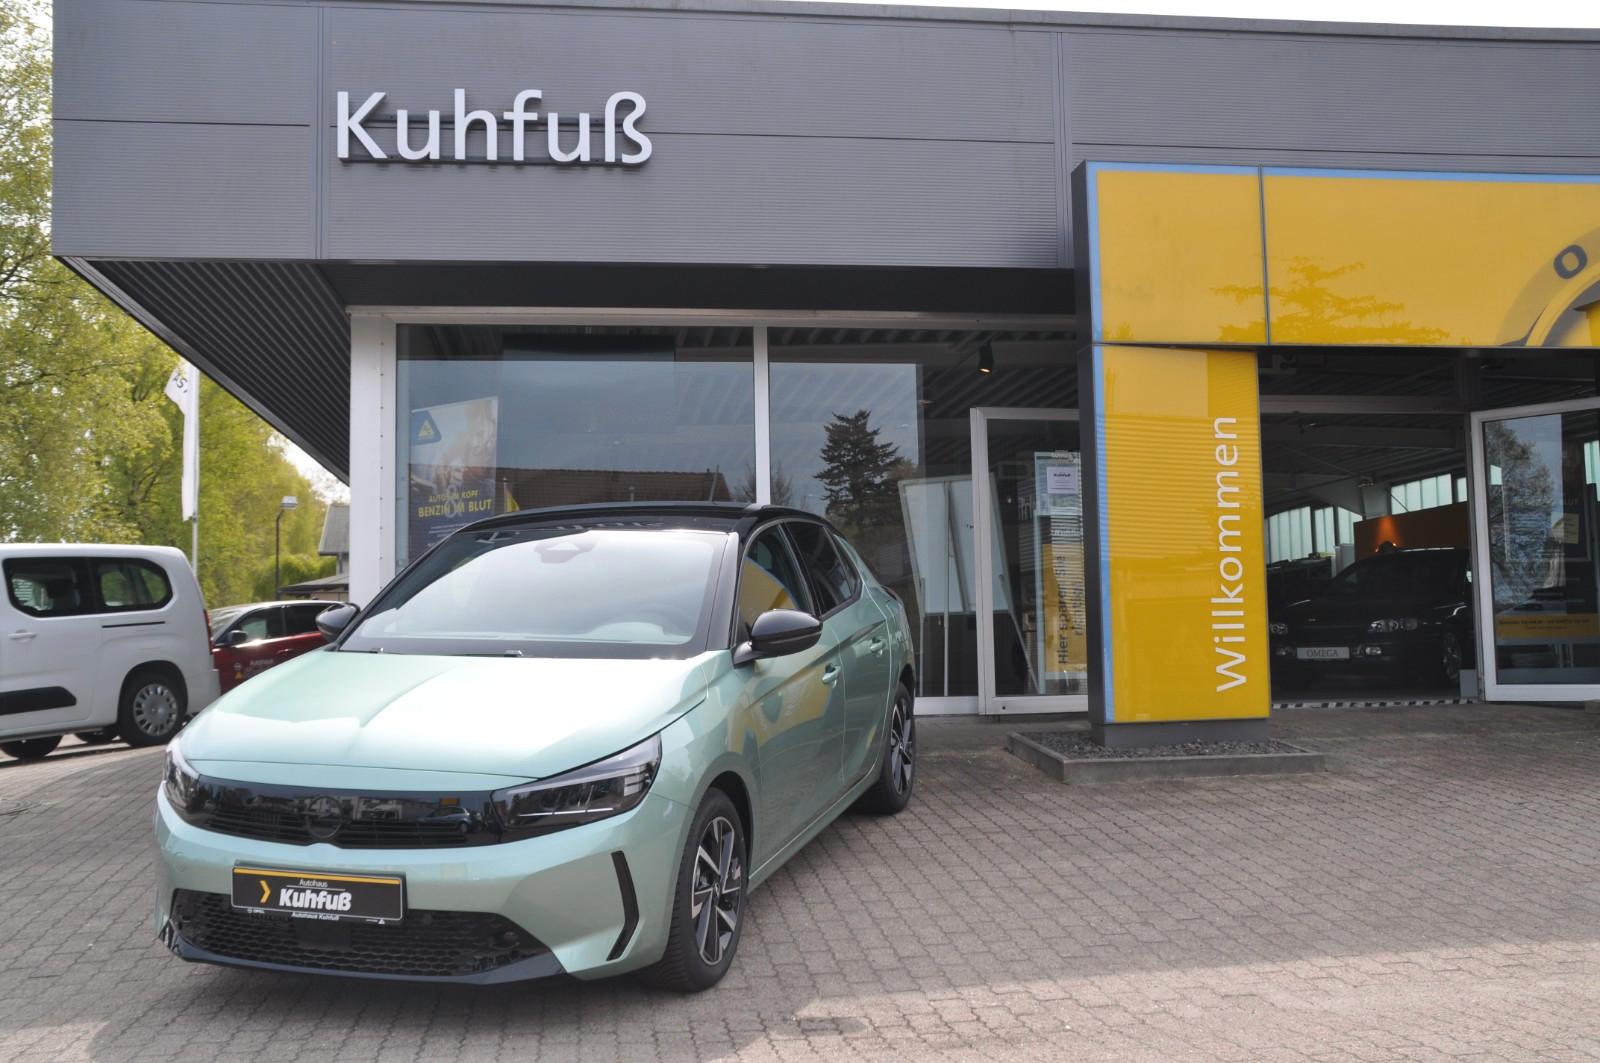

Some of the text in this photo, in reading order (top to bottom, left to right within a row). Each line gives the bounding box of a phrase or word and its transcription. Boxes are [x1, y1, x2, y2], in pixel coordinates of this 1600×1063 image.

[337, 88, 653, 164] Kuhfuß
[418, 504, 451, 517] BENZIN
[468, 499, 492, 511] BLUT
[1211, 417, 1247, 692] Willkommen
[1056, 583, 1070, 631] sparen
[1057, 634, 1069, 664] Hier
[1306, 649, 1339, 657] OMEGA
[299, 879, 328, 888] Autohaus
[279, 888, 352, 911] Kuhfuß
